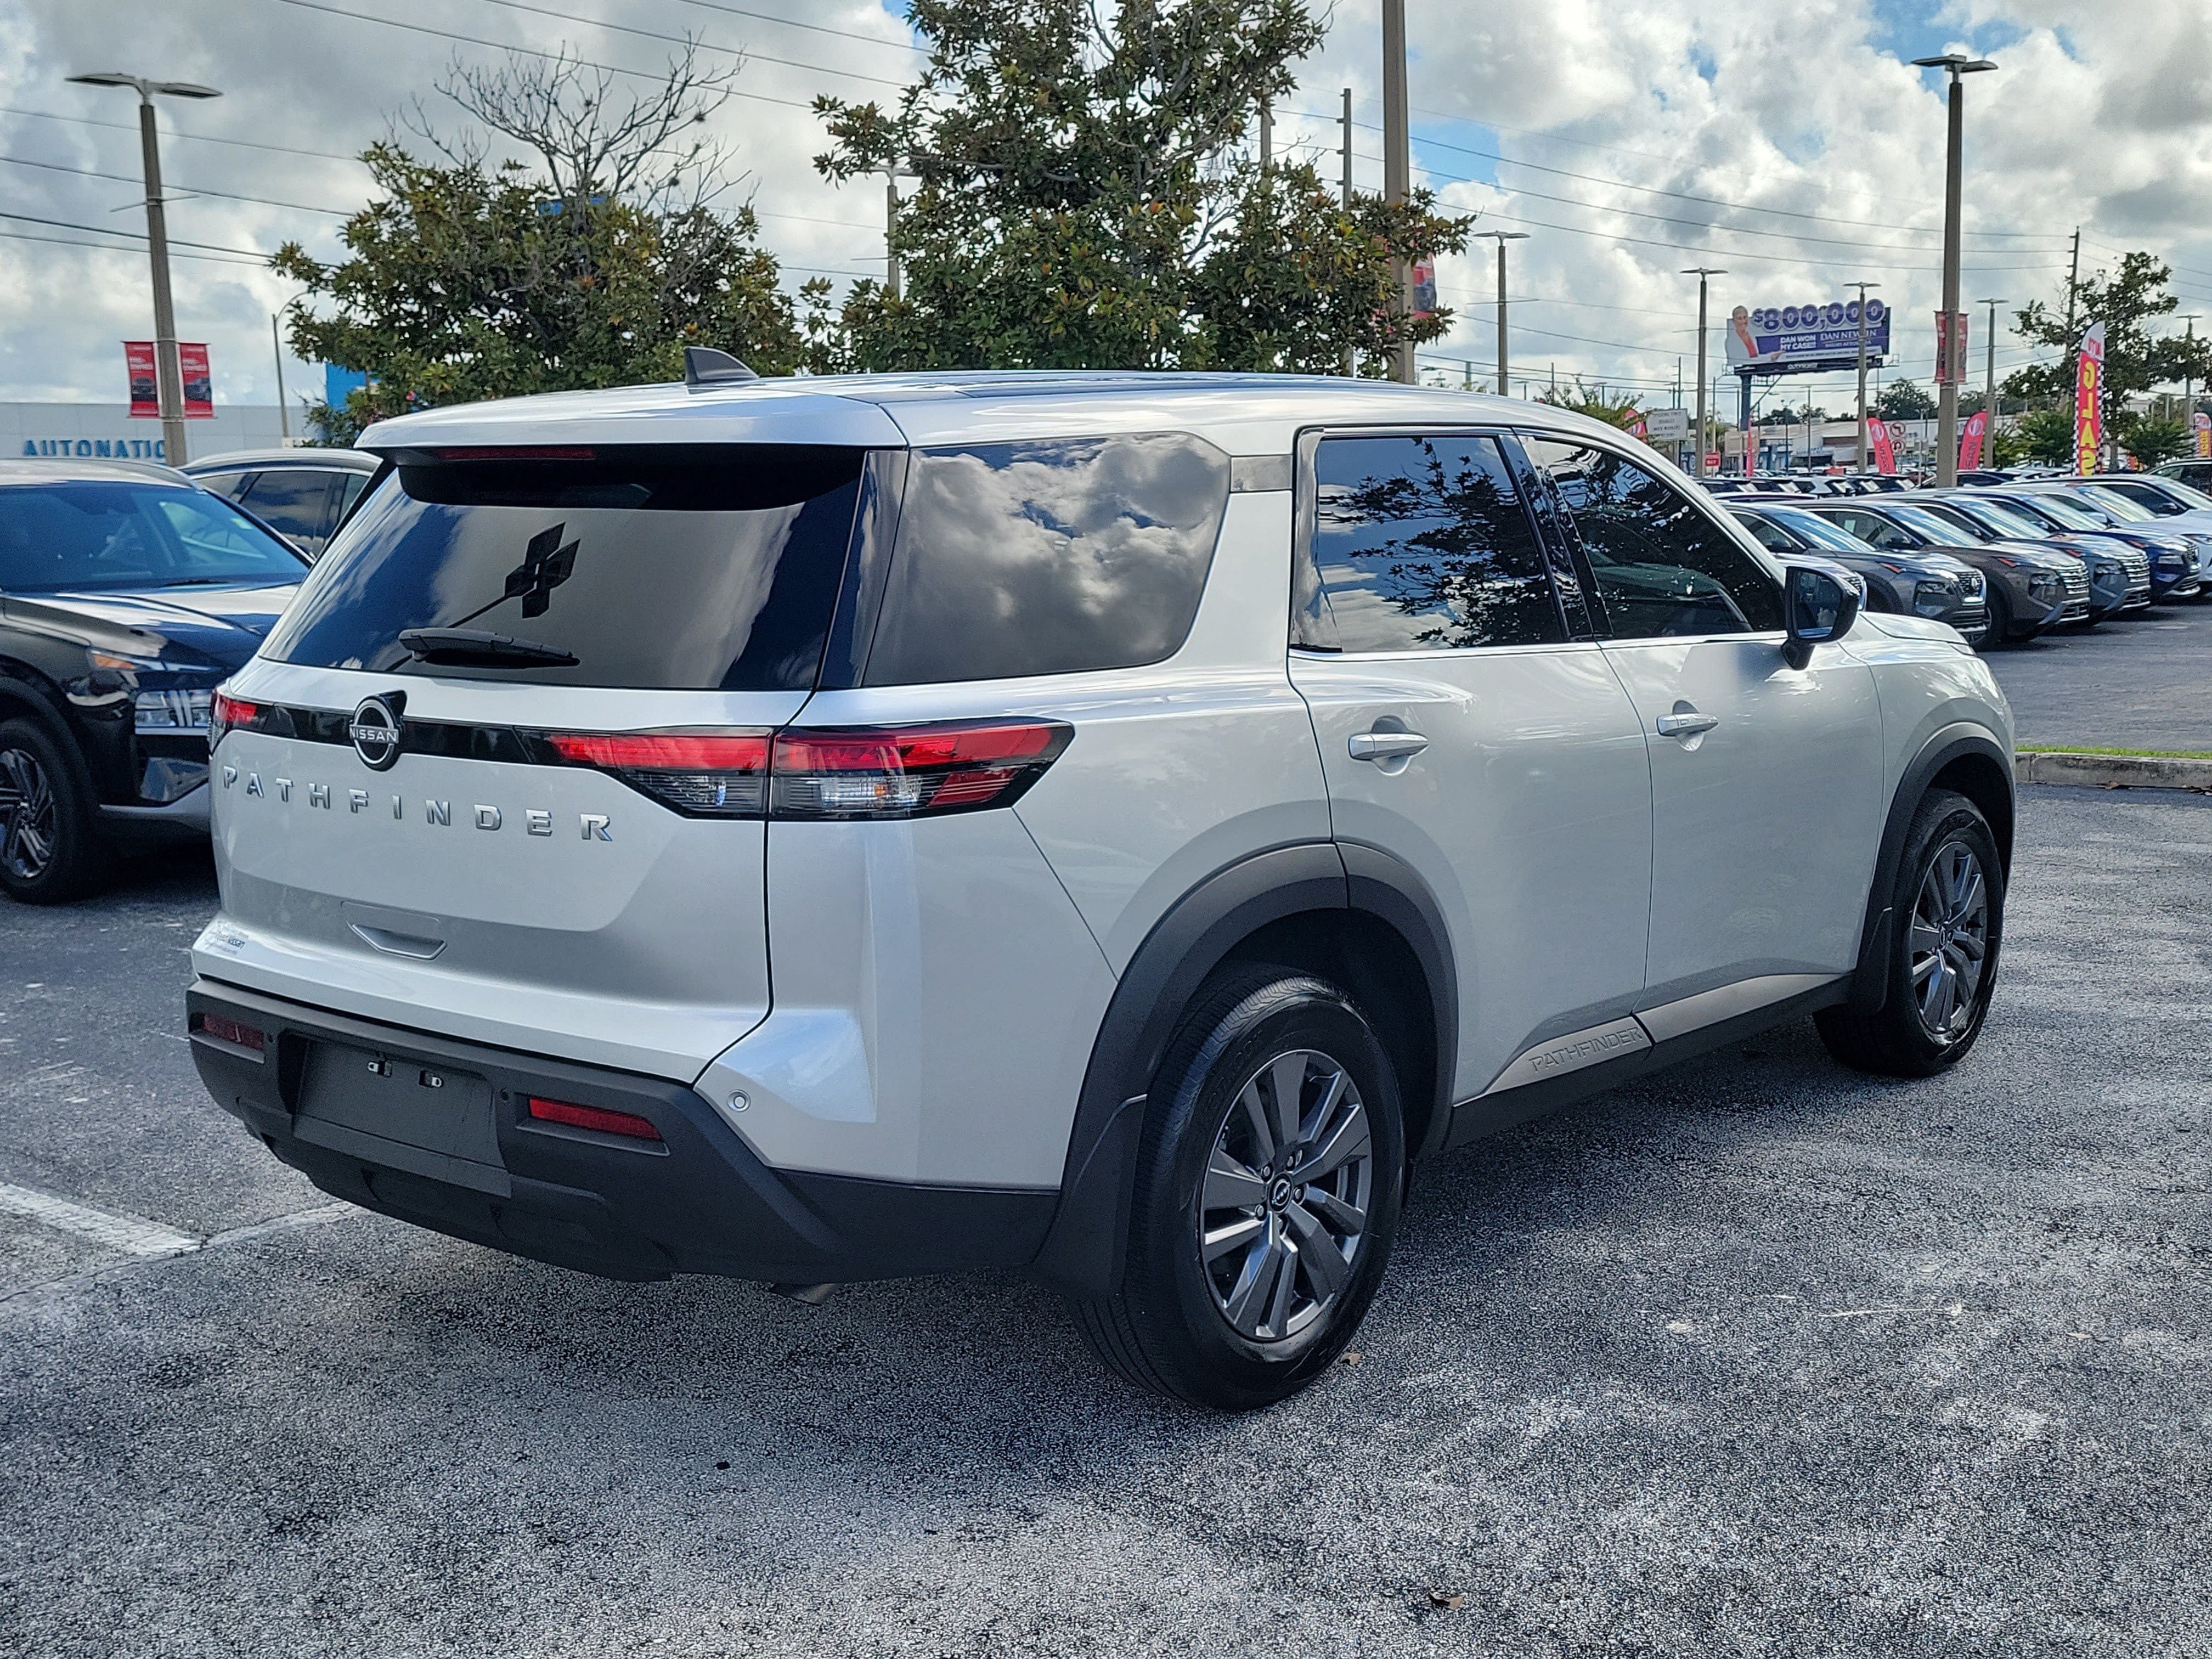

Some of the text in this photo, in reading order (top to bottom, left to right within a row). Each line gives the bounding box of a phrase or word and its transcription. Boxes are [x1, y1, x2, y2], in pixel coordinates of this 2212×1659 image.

[1753, 299, 1884, 331] $800,000
[1841, 330, 1877, 339] NEWIN
[349, 727, 397, 742] NISSAN
[224, 766, 612, 842] PATHFINDER
[1528, 1027, 1643, 1073] PATHFINDER
